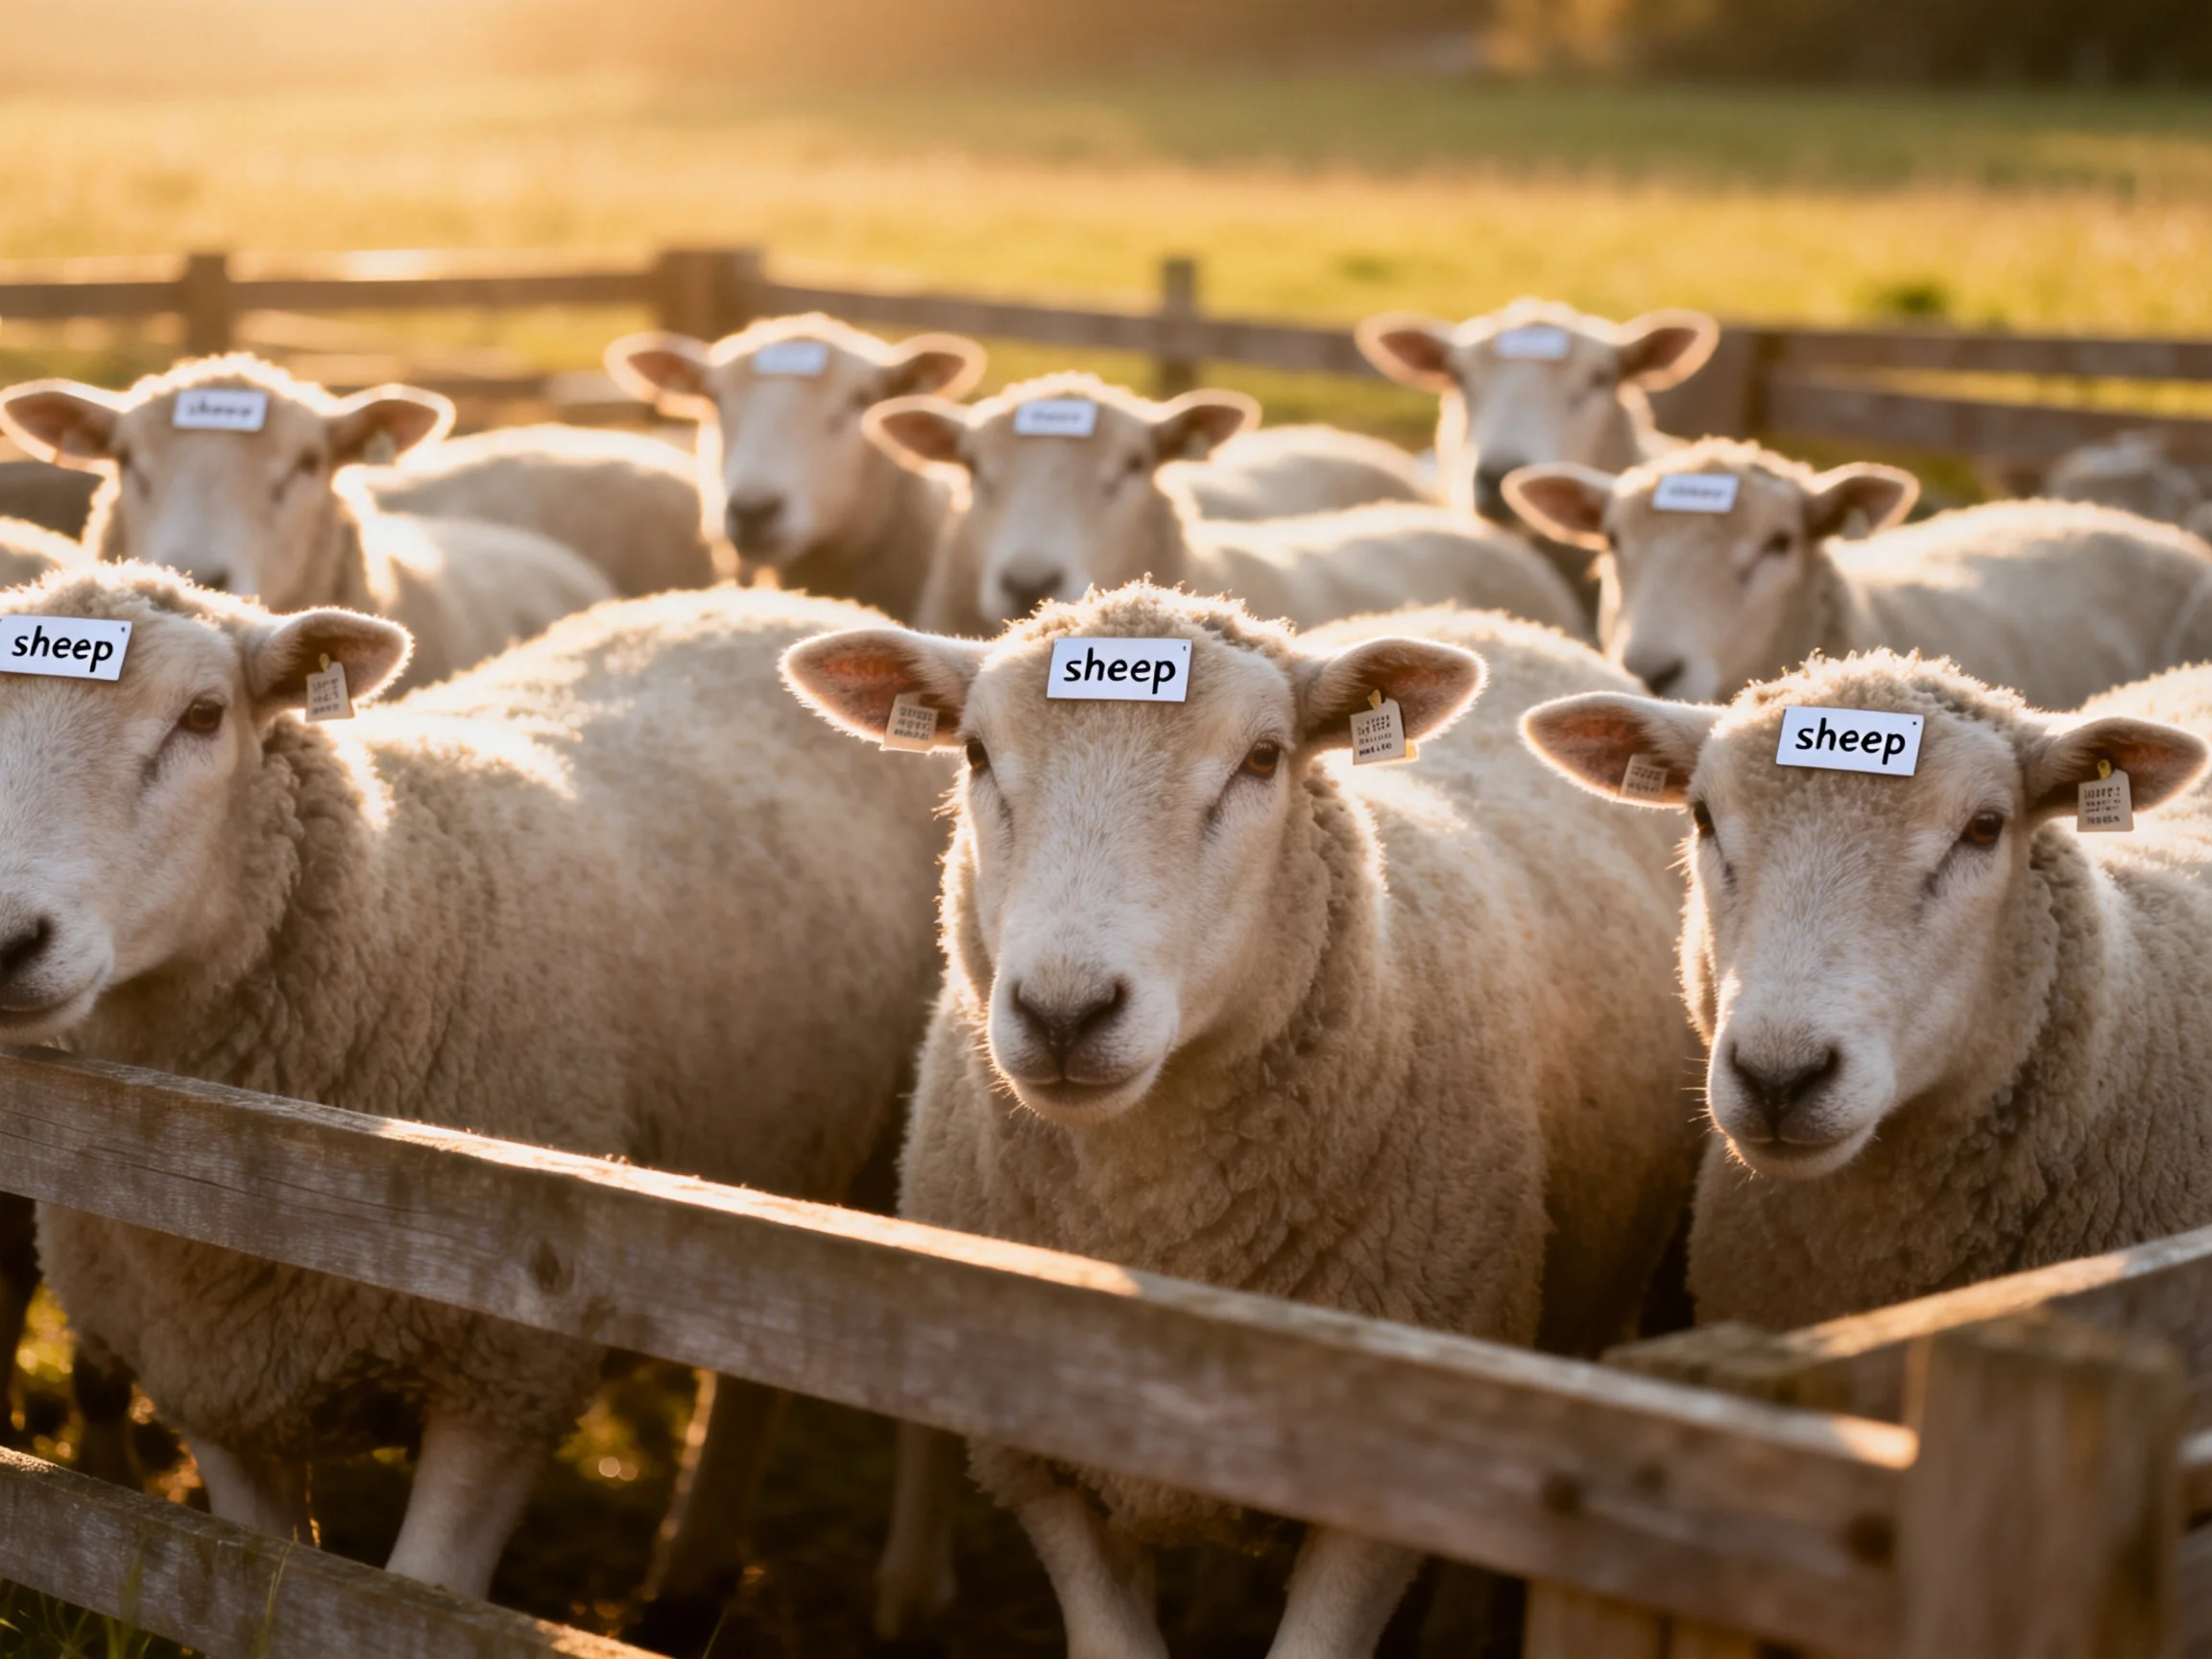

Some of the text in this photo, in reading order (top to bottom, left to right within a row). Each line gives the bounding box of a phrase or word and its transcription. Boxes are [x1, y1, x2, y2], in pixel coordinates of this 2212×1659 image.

[12, 625, 112, 673] sheep
[1064, 648, 1175, 694] sheep
[1795, 717, 1906, 765] sheep
